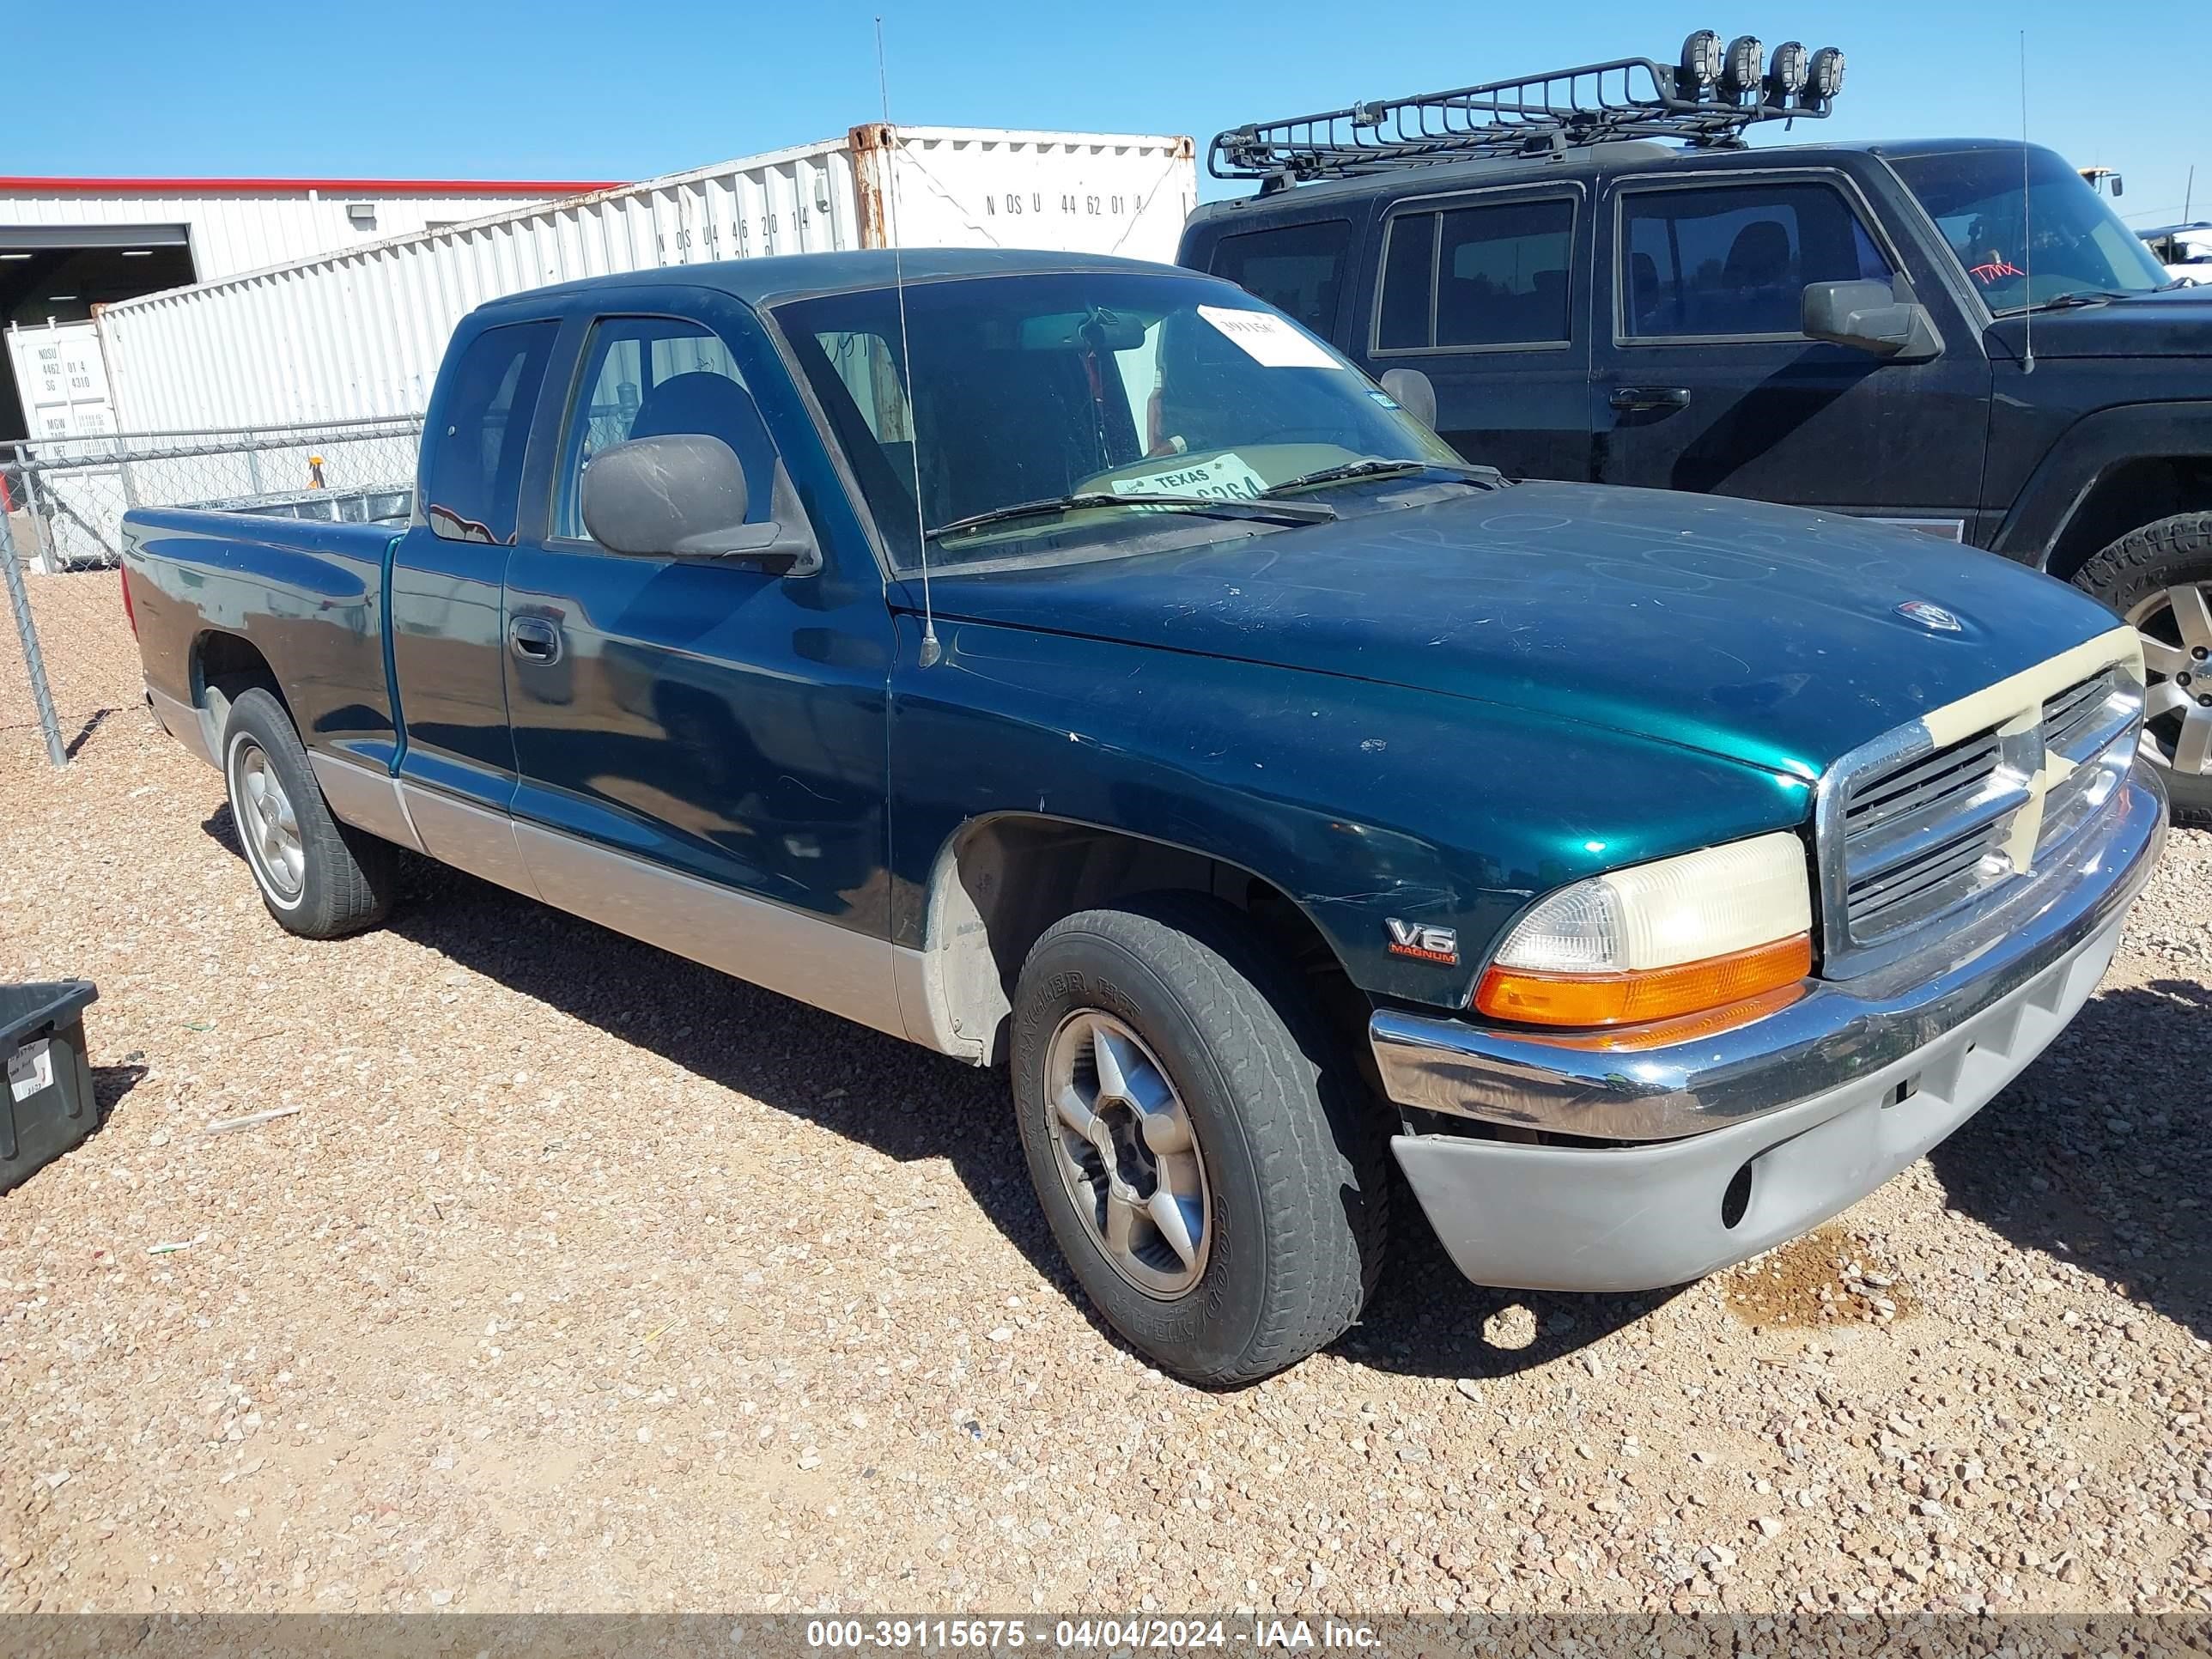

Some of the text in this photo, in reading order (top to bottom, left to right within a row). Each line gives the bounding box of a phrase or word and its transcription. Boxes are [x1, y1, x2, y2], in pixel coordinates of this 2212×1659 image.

[1706, 36, 1723, 77] KC
[1794, 47, 1808, 86] KC
[1969, 261, 2026, 285] TMX
[39, 348, 57, 359] NOSU
[71, 377, 89, 388] 4310
[47, 419, 65, 429] MGW
[1154, 470, 1209, 489] TEXAS
[1385, 917, 1457, 953] V6
[1390, 945, 1457, 963] MAGNUM
